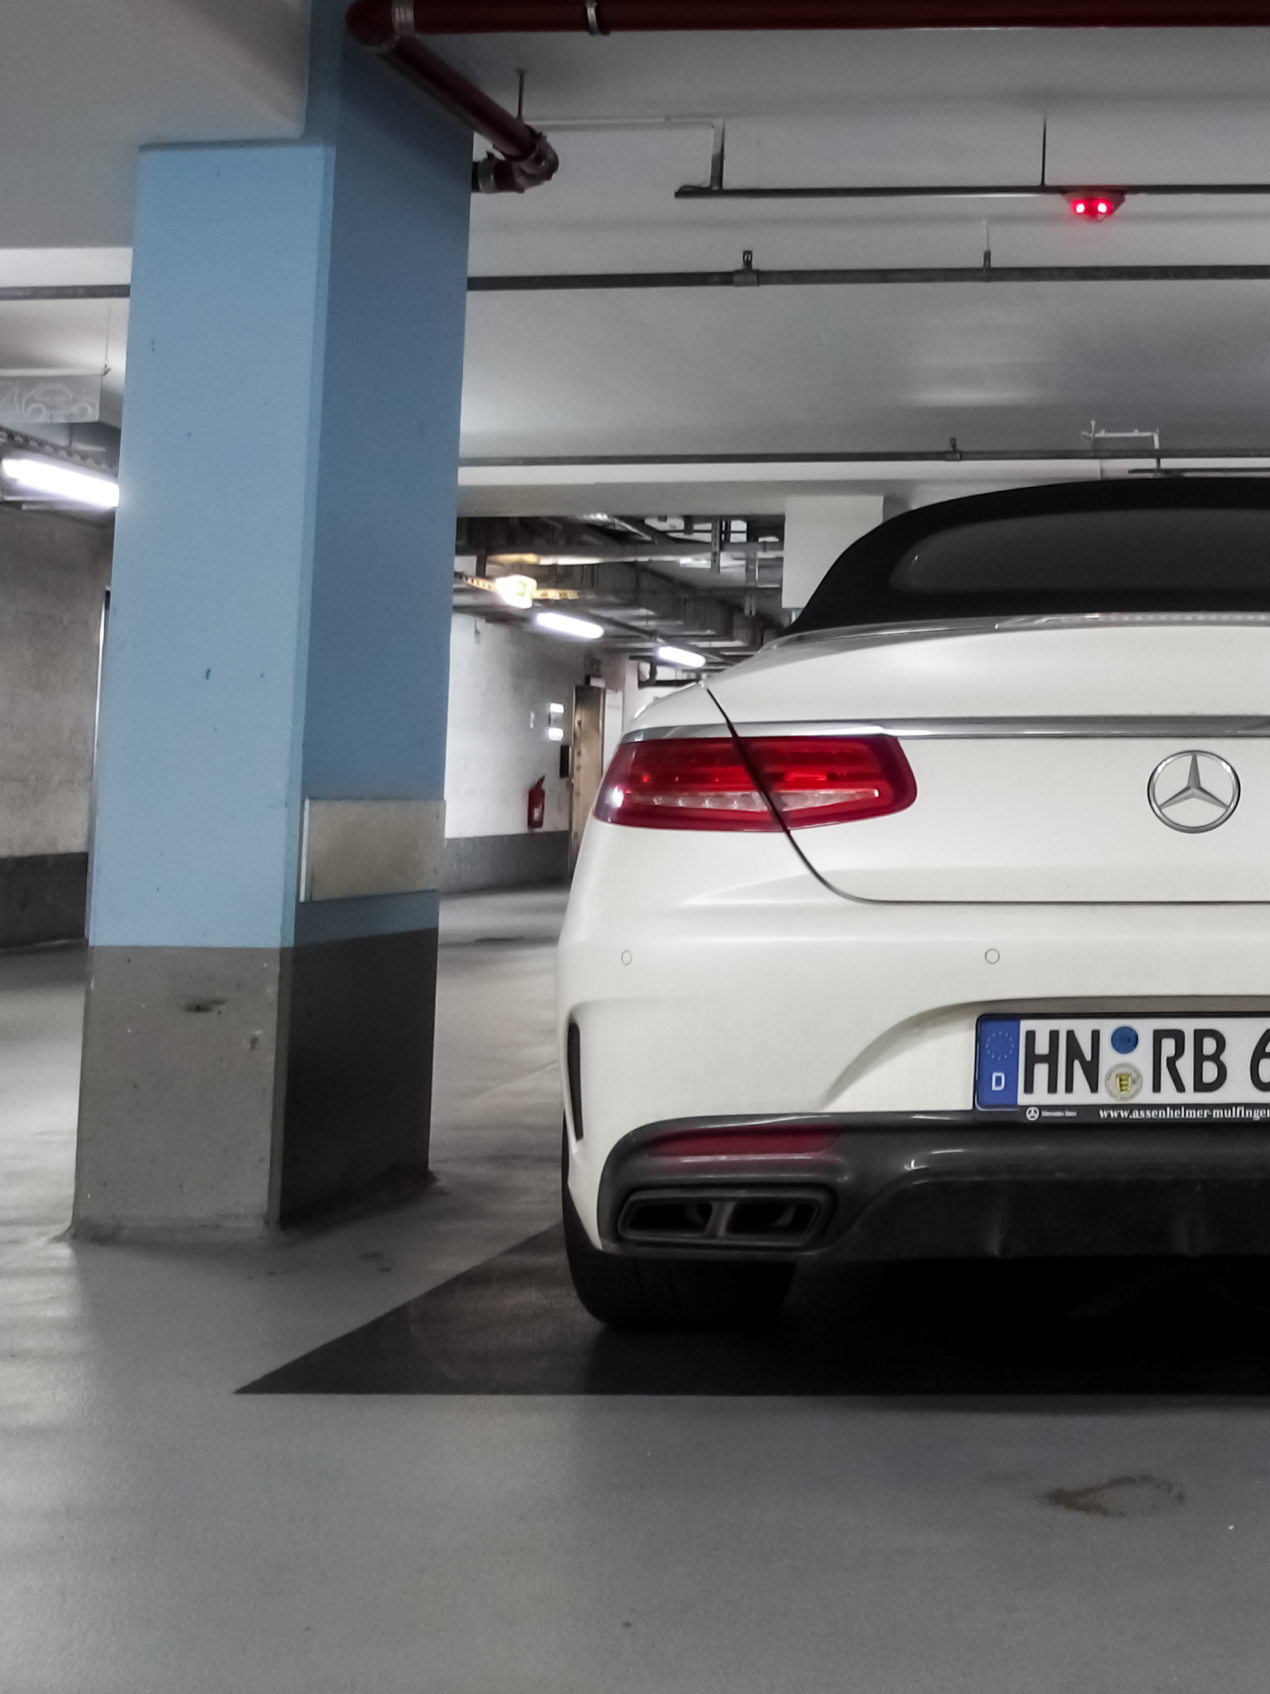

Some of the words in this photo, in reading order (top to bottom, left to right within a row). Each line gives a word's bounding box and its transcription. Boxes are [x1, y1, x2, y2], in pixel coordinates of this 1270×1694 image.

[991, 1072, 1006, 1091] D
[1023, 1029, 1100, 1094] HN
[1152, 1029, 1227, 1094] RB
